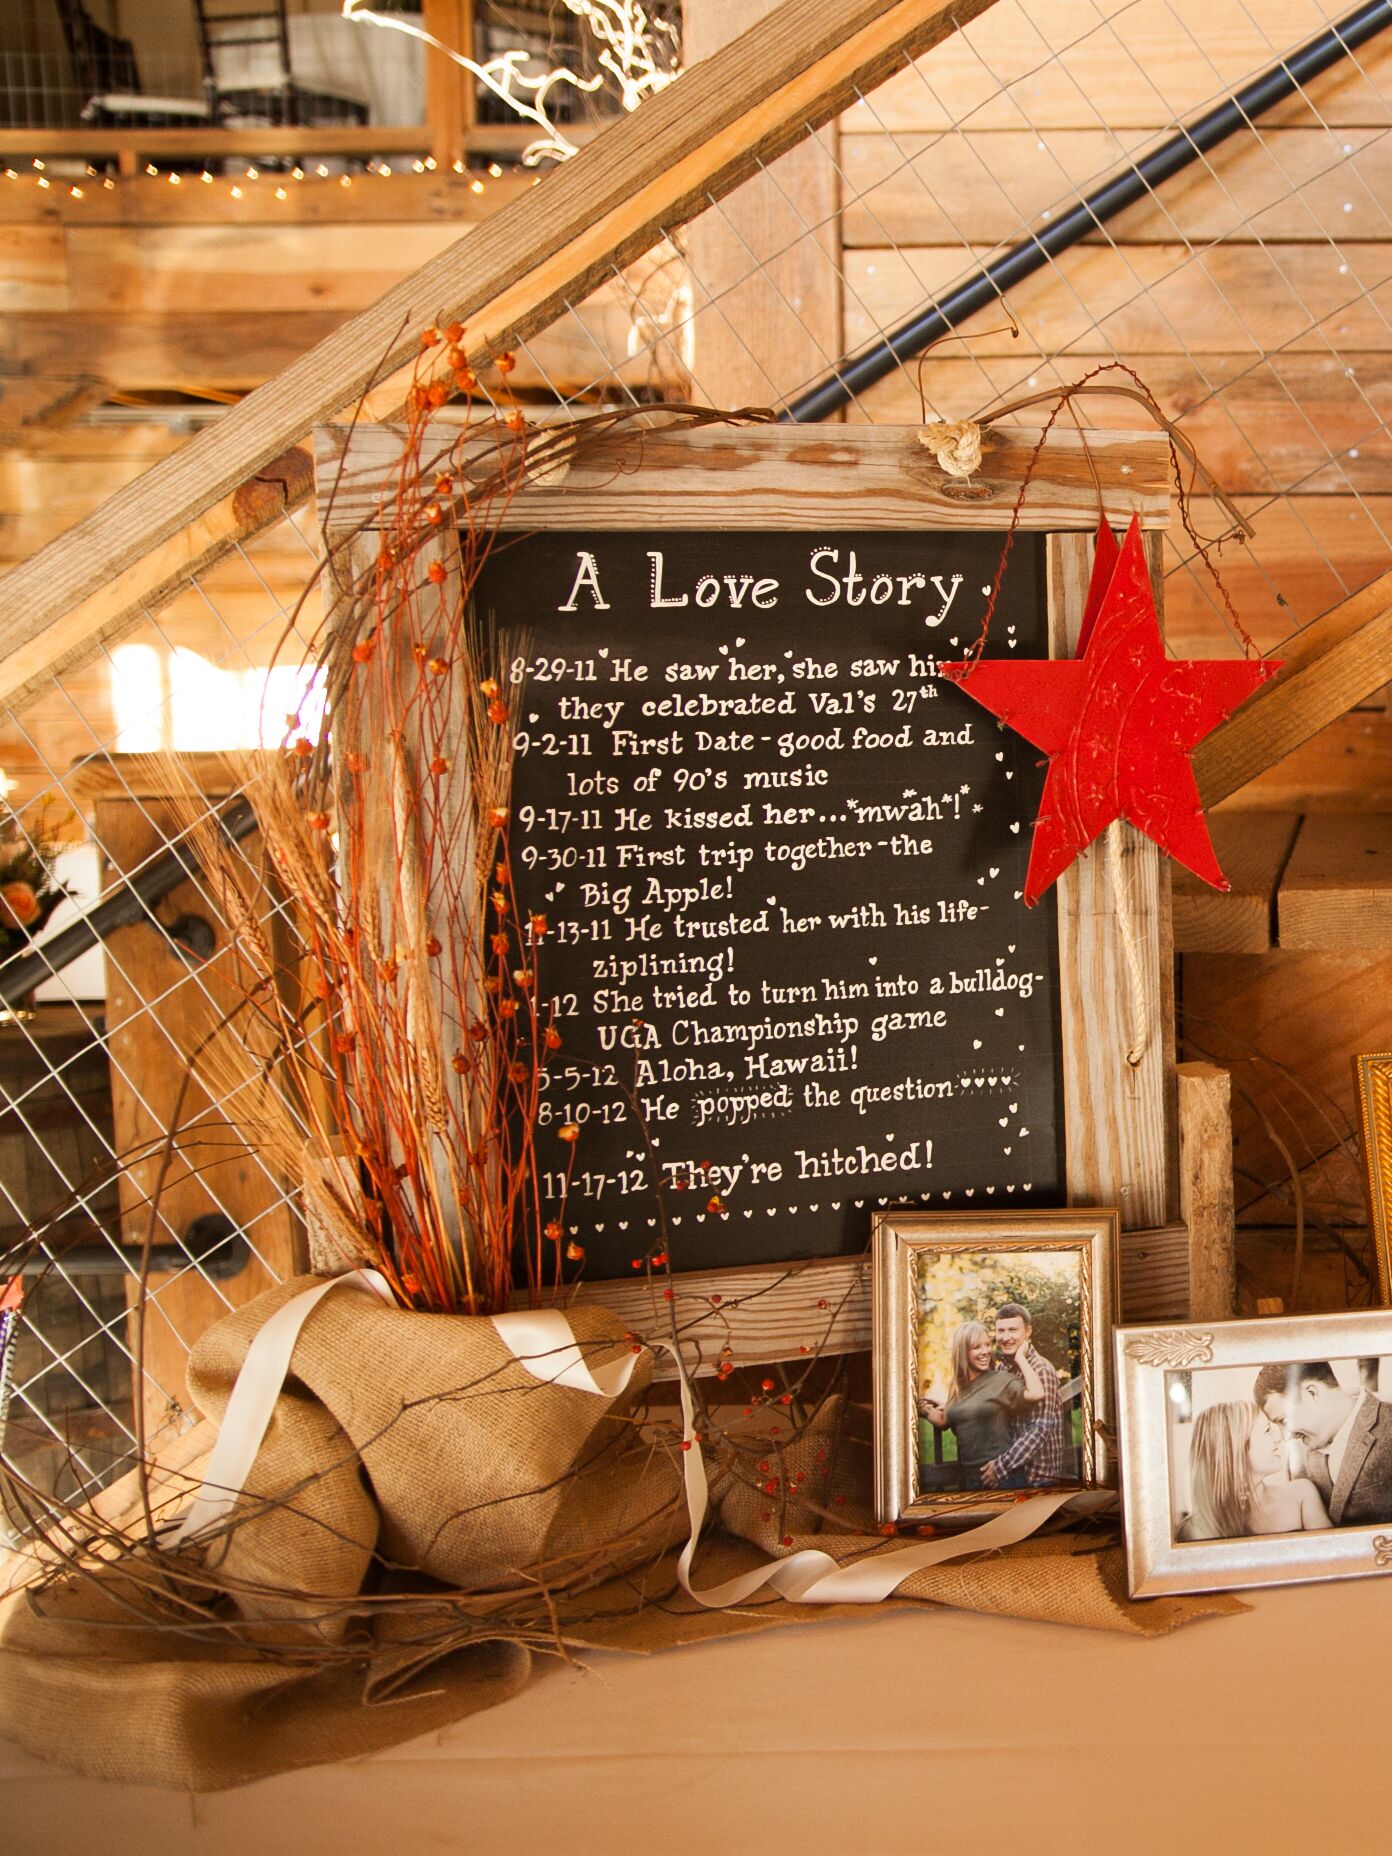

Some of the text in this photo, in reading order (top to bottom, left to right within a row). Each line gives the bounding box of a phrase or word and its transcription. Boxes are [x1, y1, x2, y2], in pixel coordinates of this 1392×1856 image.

[557, 546, 964, 628] A Love Story
[509, 656, 598, 684] 8-29-11
[609, 658, 649, 682] He
[664, 662, 720, 683] saw
[728, 657, 785, 685] her,
[792, 657, 839, 680] she
[850, 658, 901, 678] saw
[557, 684, 939, 729] they celebrated Val's 27th
[512, 731, 592, 757] 9-2-11
[611, 730, 684, 756] First
[851, 724, 914, 750] food
[922, 723, 975, 746] and
[566, 763, 829, 796] lots of 90's music
[519, 805, 603, 834] 9-17-11
[614, 807, 653, 832] He
[663, 803, 754, 829] kissed
[521, 845, 607, 871] 9-30-11
[615, 844, 686, 868] First
[698, 841, 754, 873] trip
[579, 875, 733, 915] Big Apple!
[624, 914, 663, 942] He
[673, 910, 770, 939] trusted
[779, 906, 822, 934] her
[827, 902, 888, 929] with
[893, 903, 931, 926] his
[936, 899, 990, 923] life-
[592, 946, 734, 986] ziplining!
[593, 988, 644, 1014] She
[652, 982, 718, 1009] tried
[727, 983, 751, 1006] to
[760, 980, 818, 1005] turn
[820, 978, 870, 1001] him
[874, 974, 919, 998] into
[929, 977, 945, 995] a
[948, 968, 1044, 999] bulldog-
[597, 1010, 947, 1051] UGA Championship game
[539, 1044, 858, 1091] 5-5-12 Aloha, Hawaii!
[538, 1076, 954, 1127] 8-10-12 He popped the question
[543, 1139, 933, 1200] 11-17-12 They're hitched!
